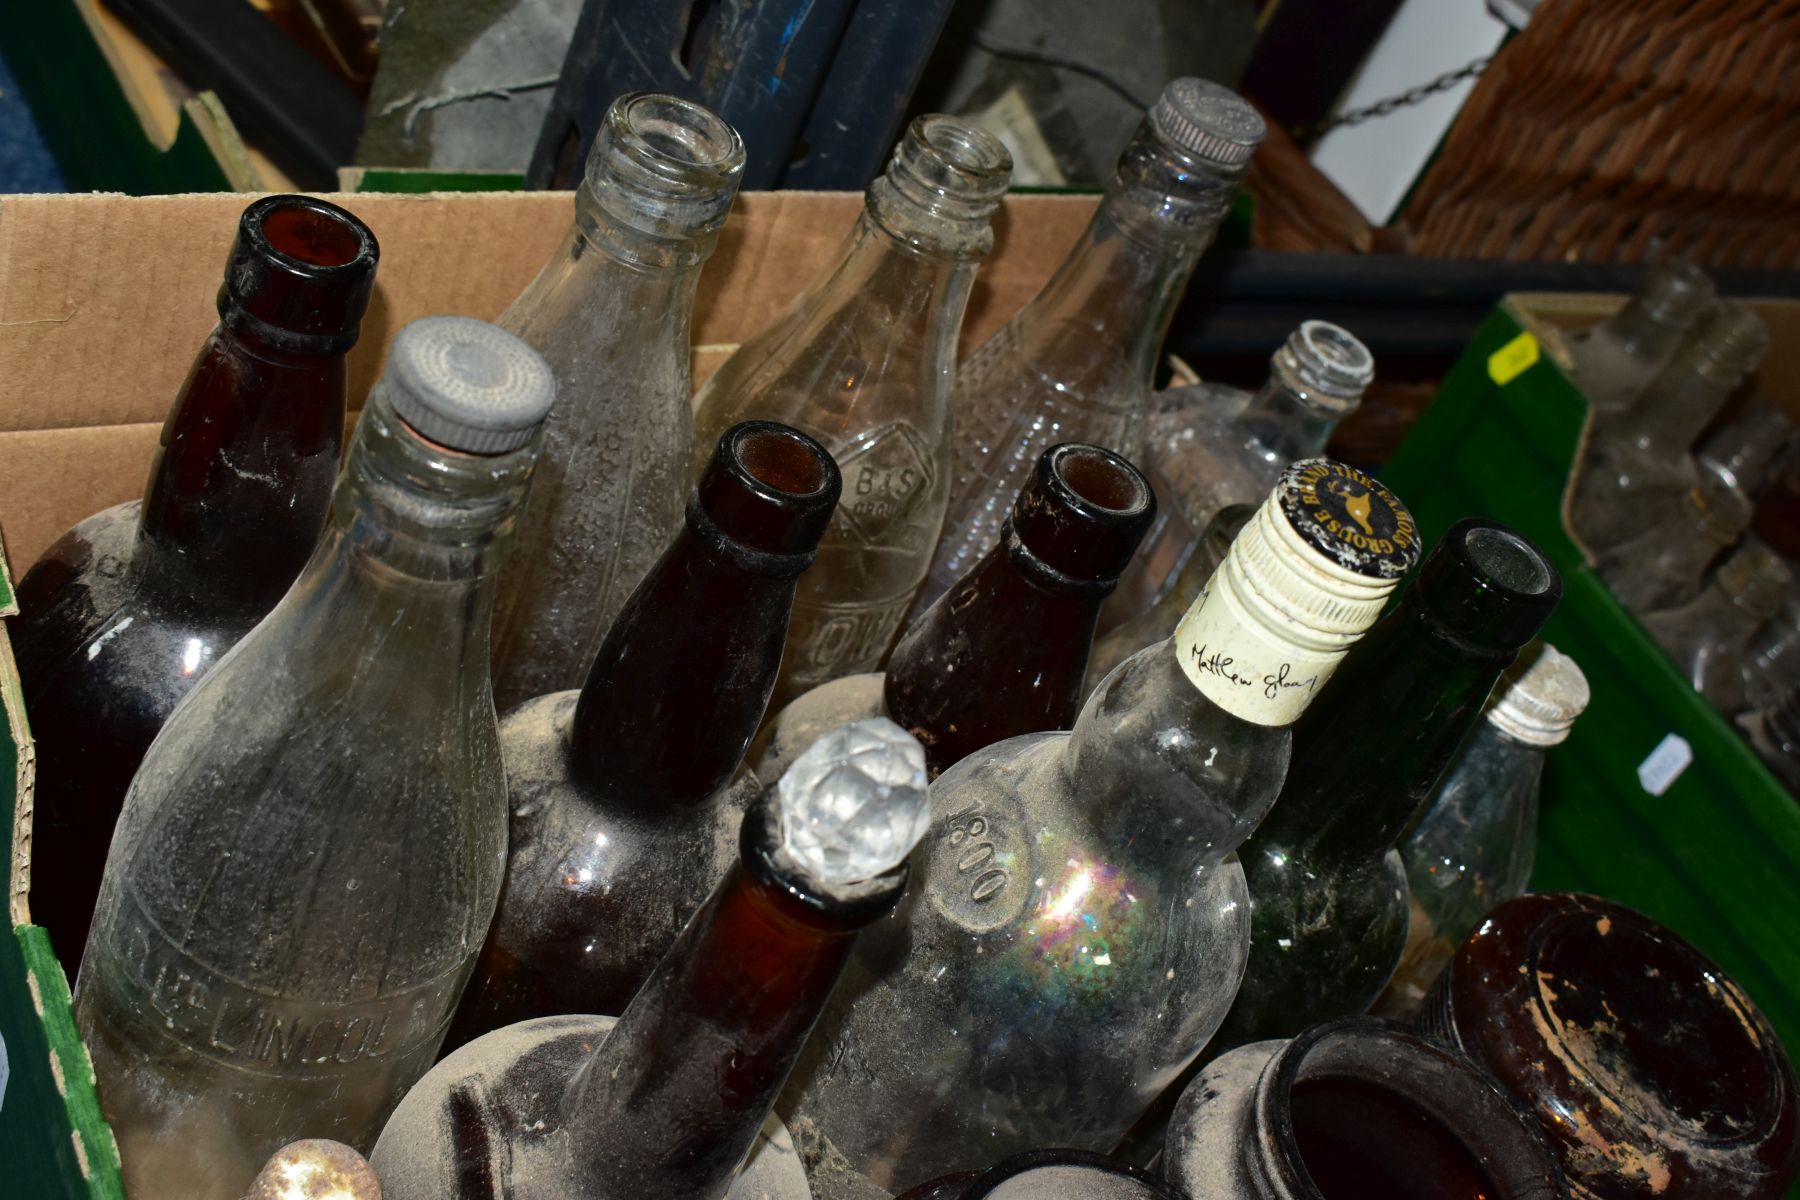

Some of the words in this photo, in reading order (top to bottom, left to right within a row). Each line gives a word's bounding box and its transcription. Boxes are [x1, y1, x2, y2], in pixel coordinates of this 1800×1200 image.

[1331, 464, 1373, 488] THE
[1314, 508, 1395, 555] GROUSE
[1376, 489, 1415, 550] FAMOUS
[1191, 643, 1252, 687] Matthew
